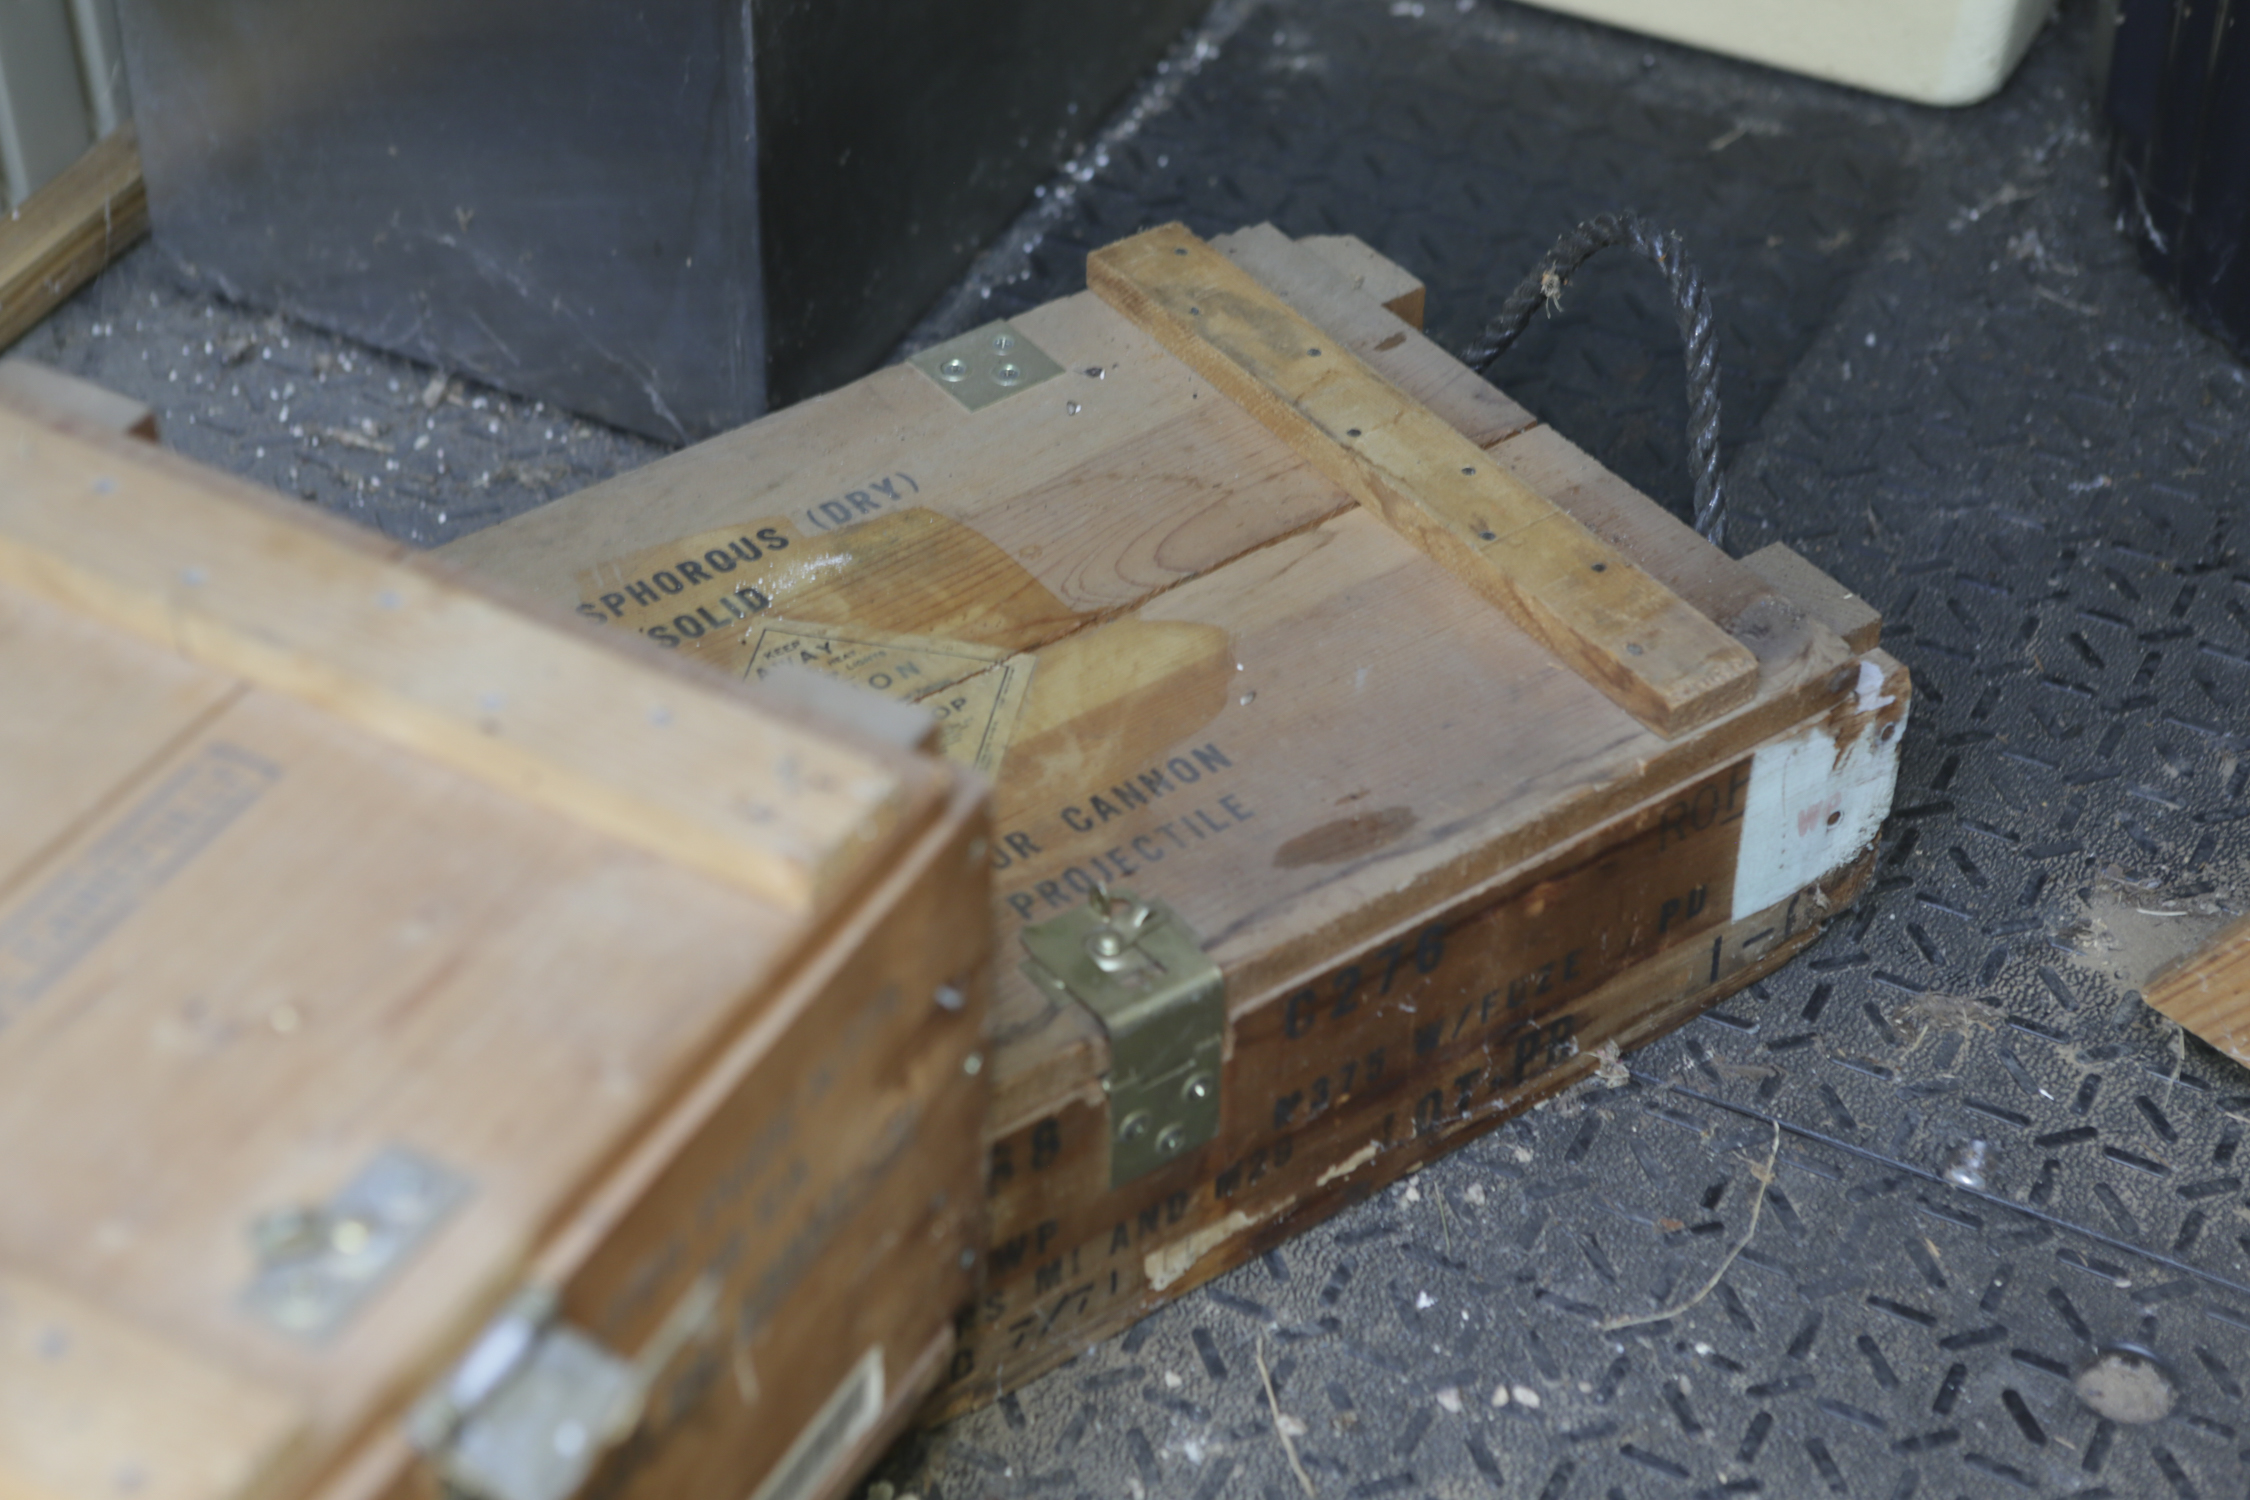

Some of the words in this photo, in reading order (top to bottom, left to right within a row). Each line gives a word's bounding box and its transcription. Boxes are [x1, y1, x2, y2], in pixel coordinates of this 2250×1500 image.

[806, 471, 920, 532] (DRY)
[647, 587, 772, 649] SOLID
[756, 641, 834, 681] AAY
[763, 639, 802, 661] KEEP
[1060, 742, 1234, 833] CANNON
[1007, 793, 1255, 921] PROJECTILE
